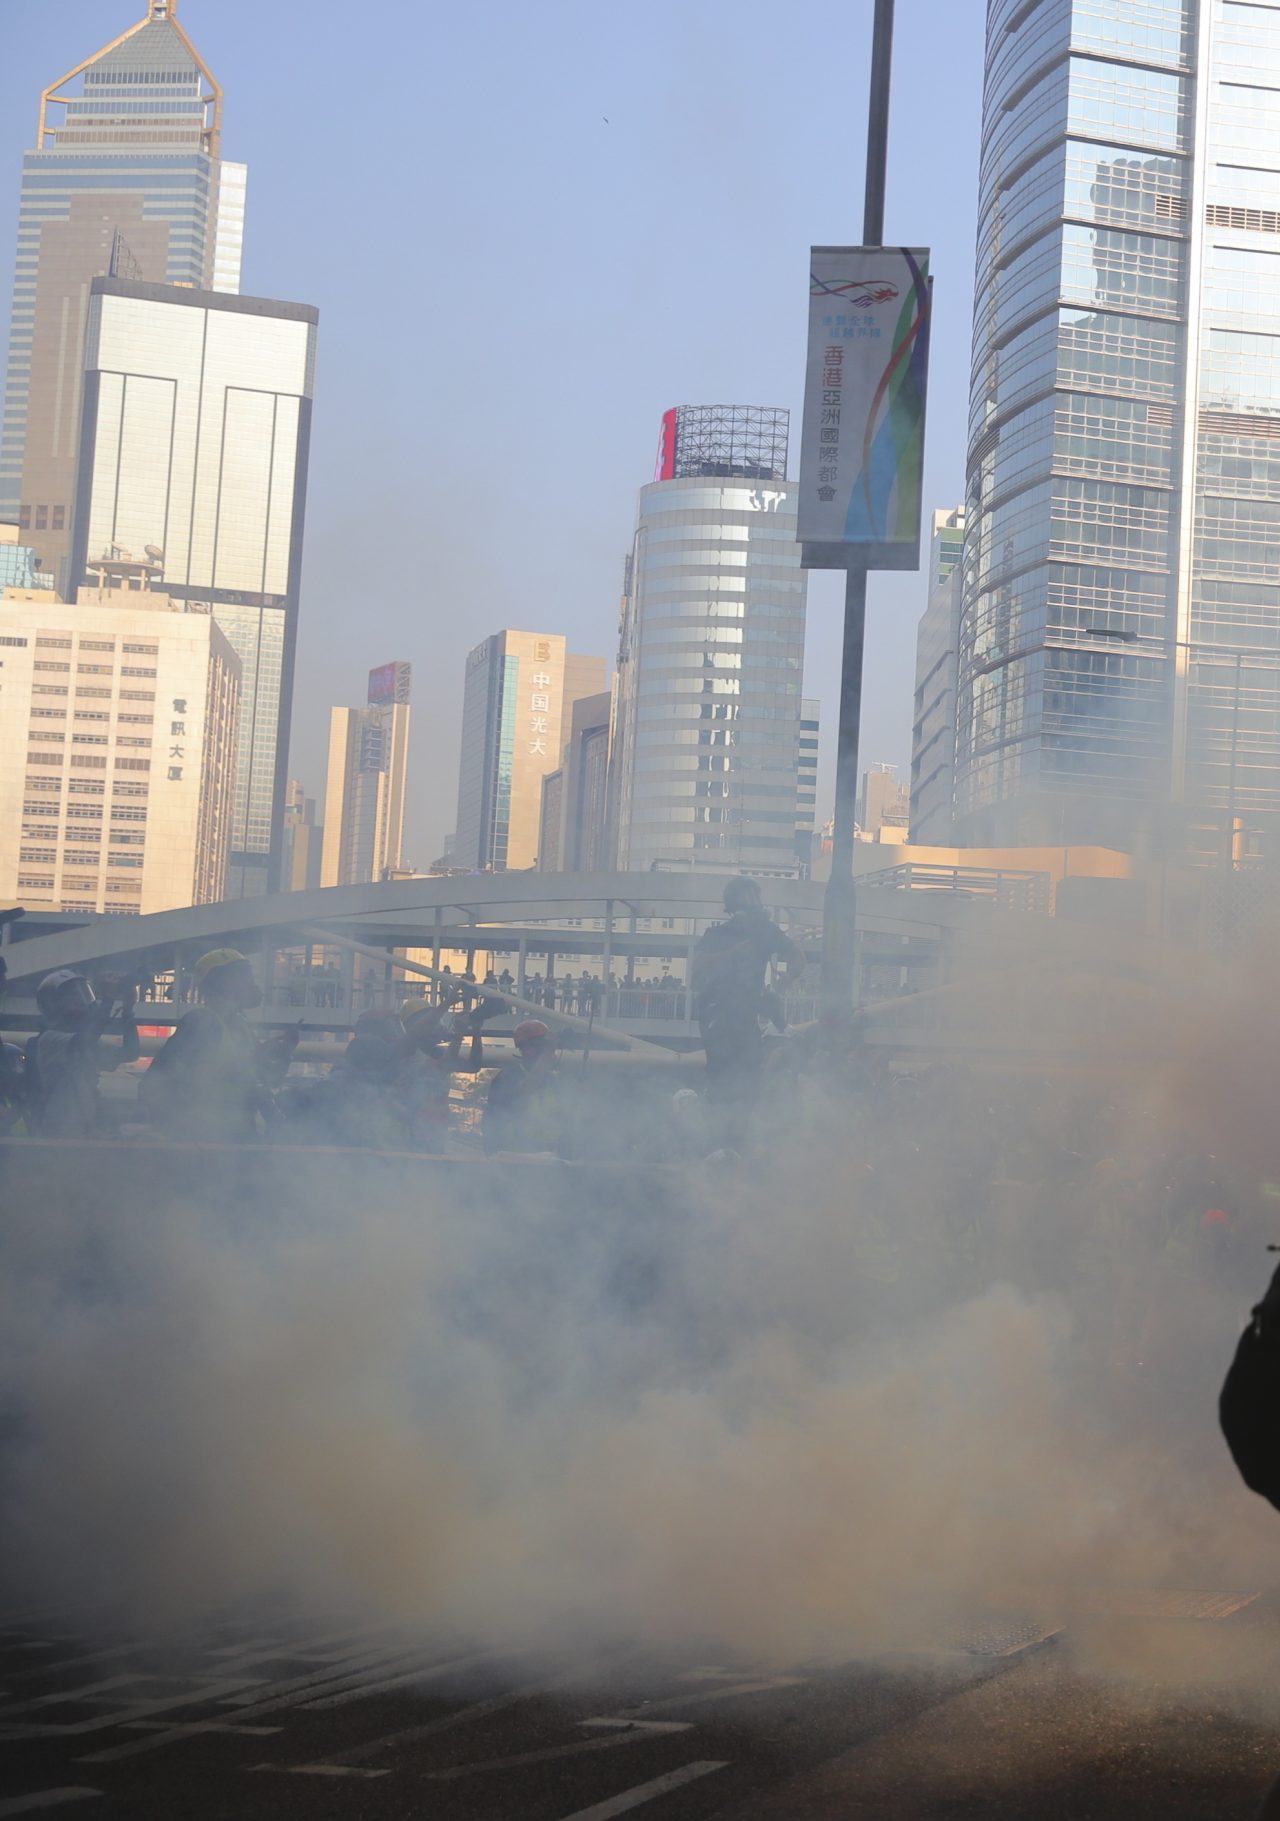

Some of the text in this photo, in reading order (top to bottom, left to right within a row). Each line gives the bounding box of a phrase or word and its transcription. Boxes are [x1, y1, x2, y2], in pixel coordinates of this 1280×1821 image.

[816, 346, 844, 502] 香港亞洲國際都會
[528, 672, 550, 756] 中国光大
